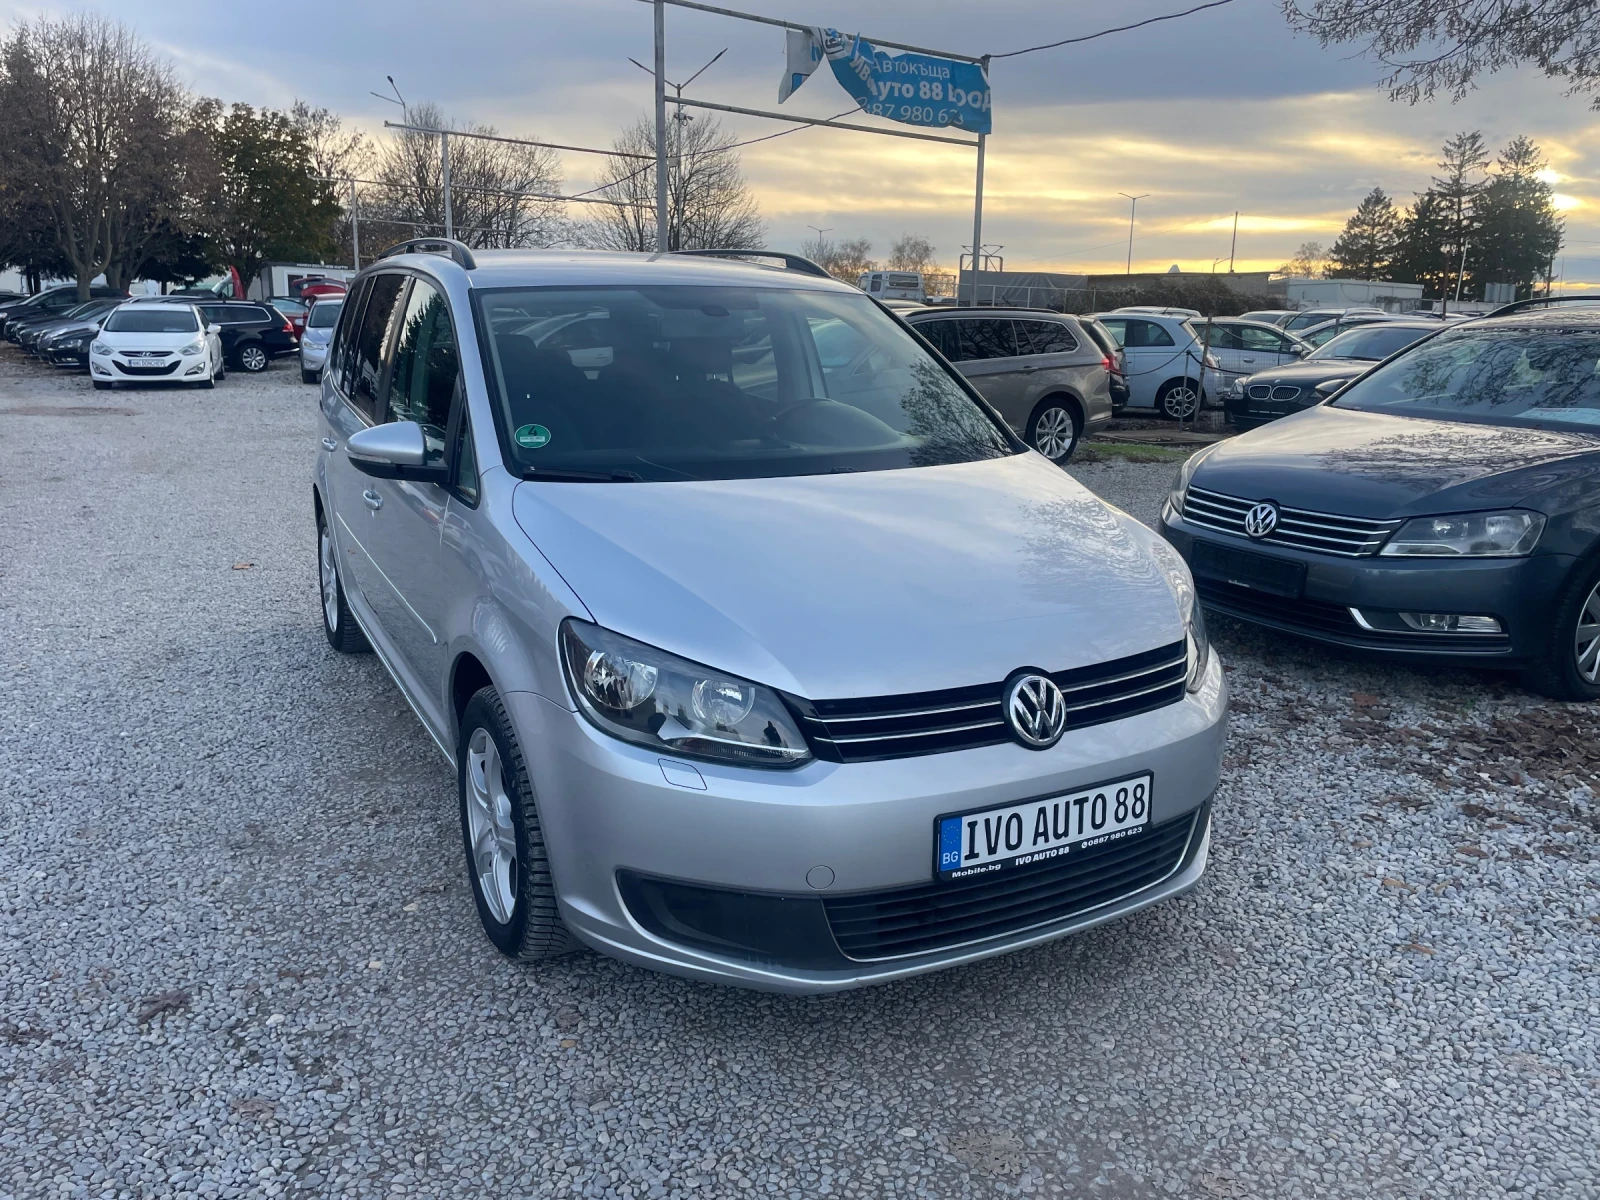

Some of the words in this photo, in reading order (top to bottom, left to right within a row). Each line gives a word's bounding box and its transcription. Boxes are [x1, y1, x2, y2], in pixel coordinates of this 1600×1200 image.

[918, 80, 944, 101] 88
[899, 104, 934, 123] 980
[527, 425, 538, 437] 4
[964, 812, 1023, 861] IVO
[1032, 793, 1107, 846] AUTO
[1114, 783, 1146, 824] 88
[1088, 834, 1110, 847] 0887
[1110, 831, 1126, 841] 980
[1127, 826, 1143, 837] 623
[942, 851, 959, 865] BG
[951, 863, 1002, 878] Mobile.bg
[1015, 855, 1032, 866] IVO
[1032, 848, 1058, 862] AUTO
[1058, 846, 1070, 855] 88
